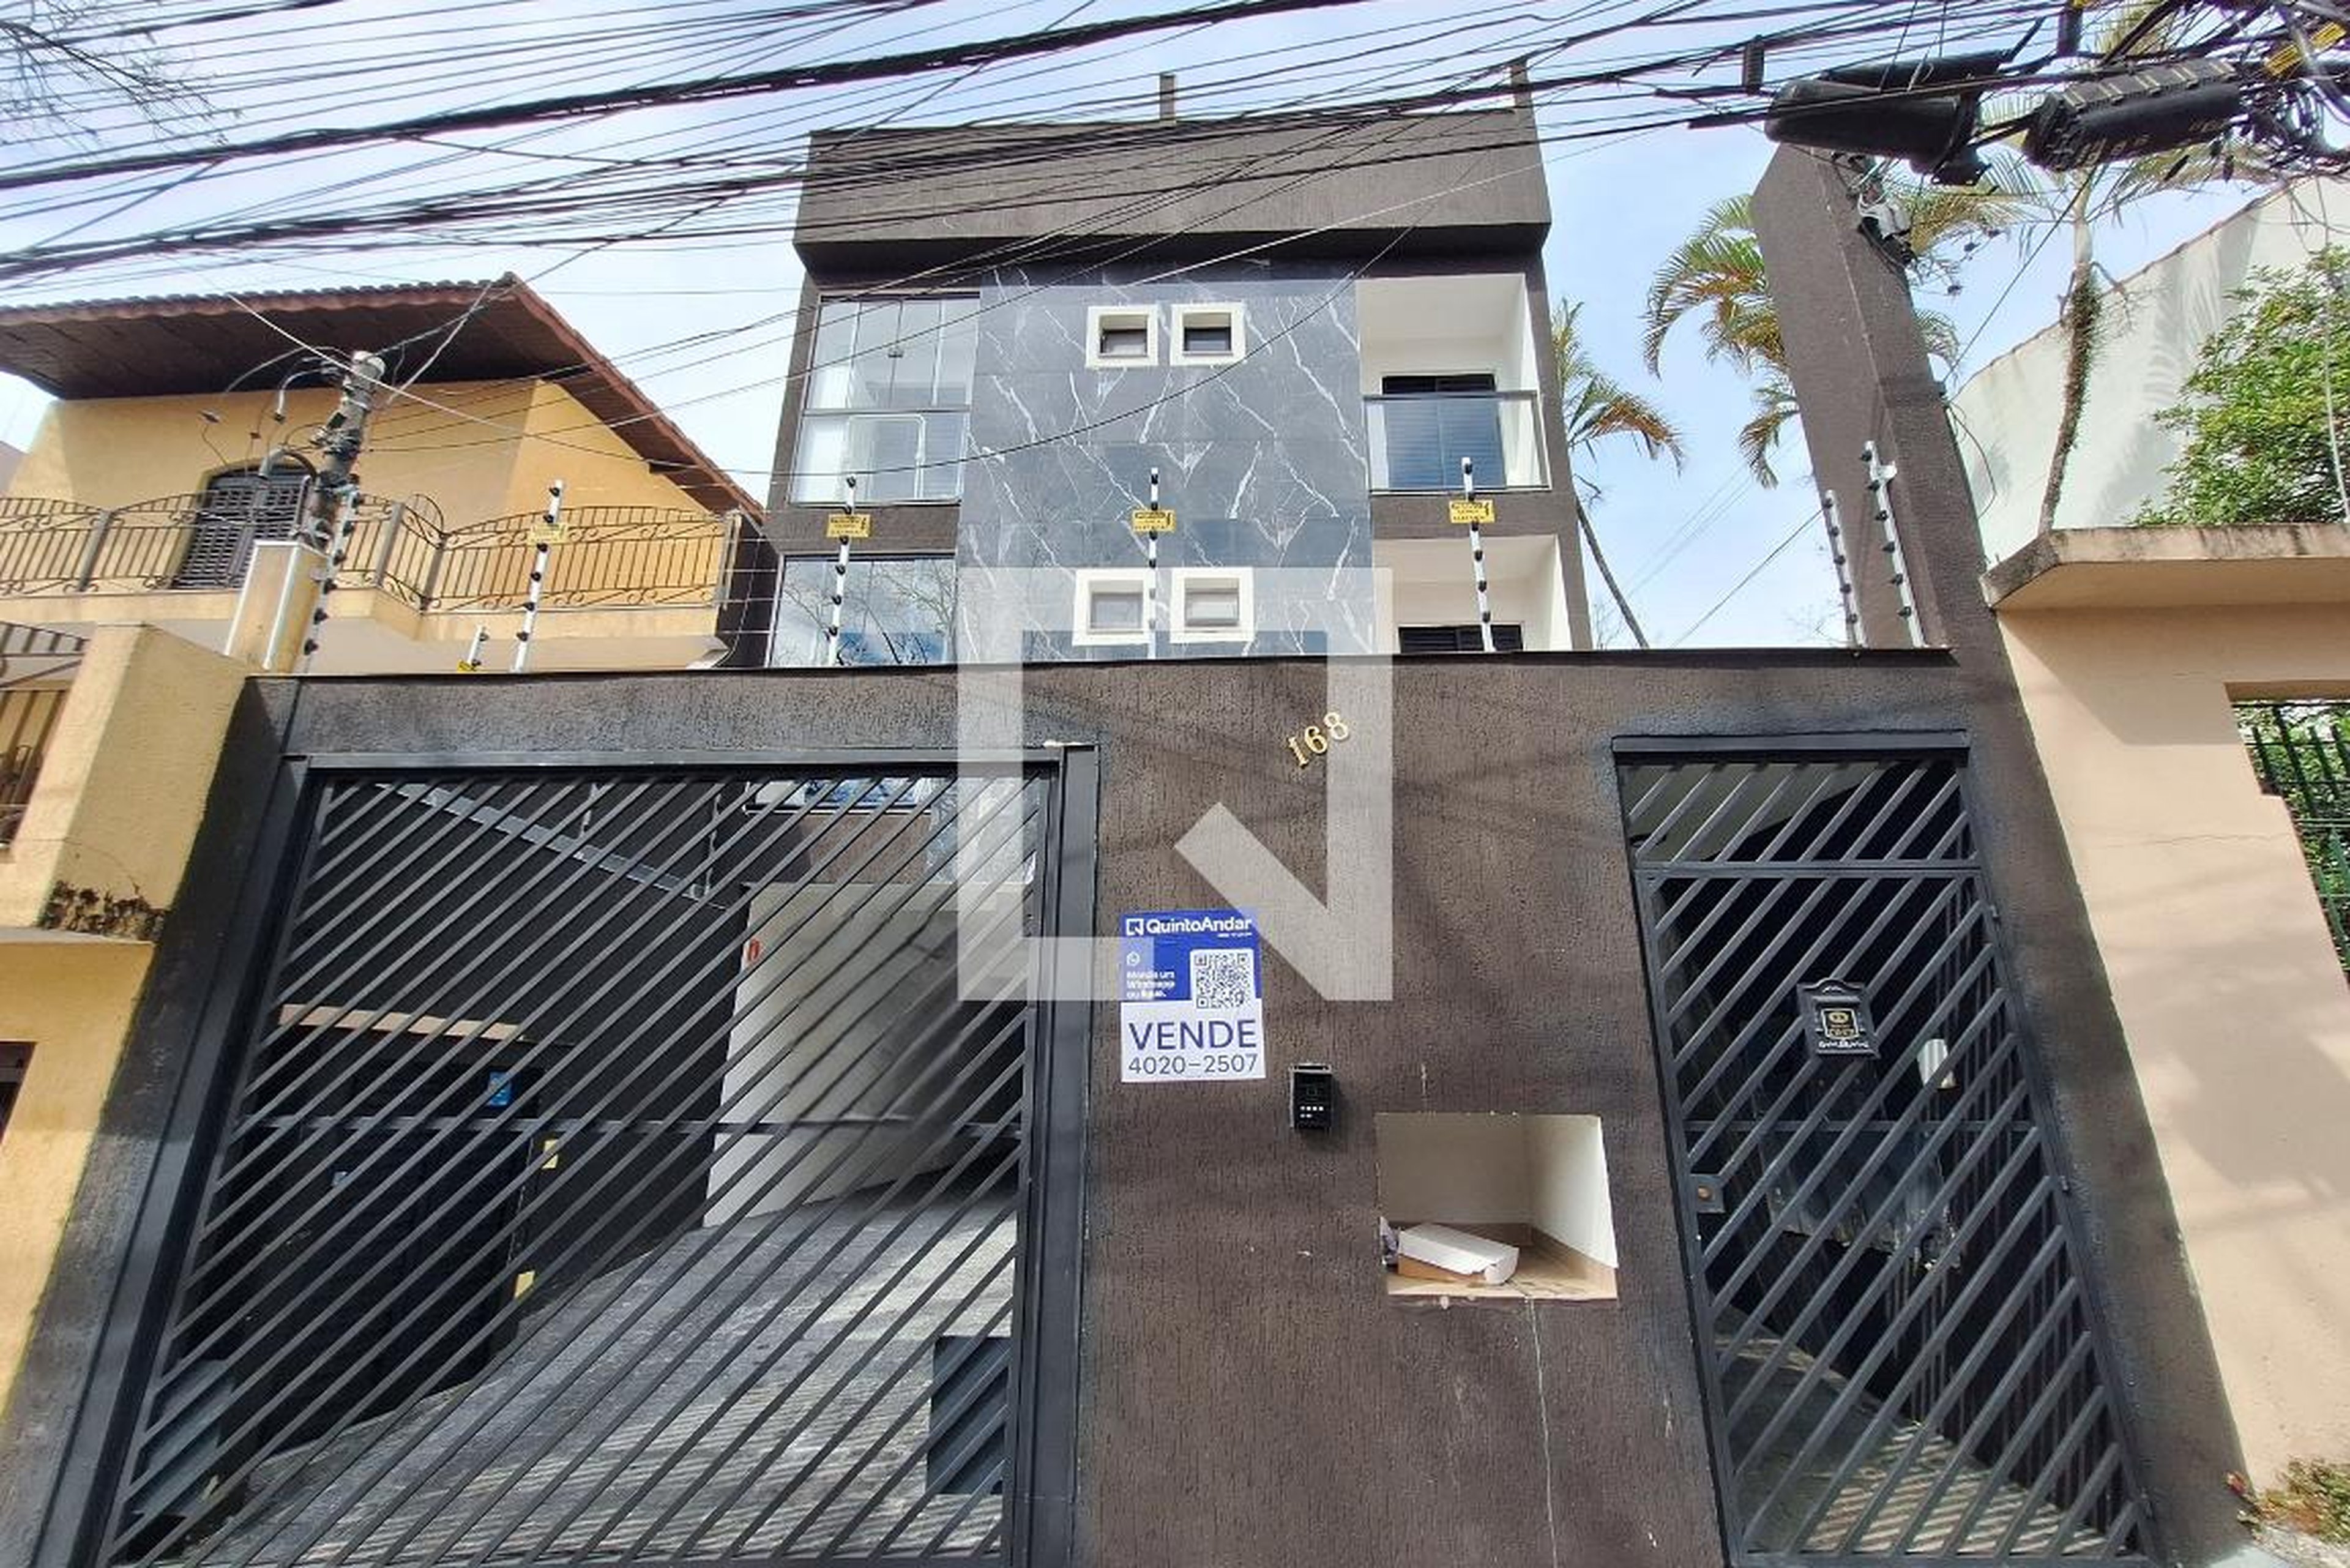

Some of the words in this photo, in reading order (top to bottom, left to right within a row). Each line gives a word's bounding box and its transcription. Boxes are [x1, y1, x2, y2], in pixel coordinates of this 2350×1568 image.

[1288, 712, 1348, 766] 168
[1146, 917, 1252, 934] QuintoAndar
[1128, 1019, 1256, 1050] VENDE
[1128, 1053, 1258, 1075] 4020-2507
